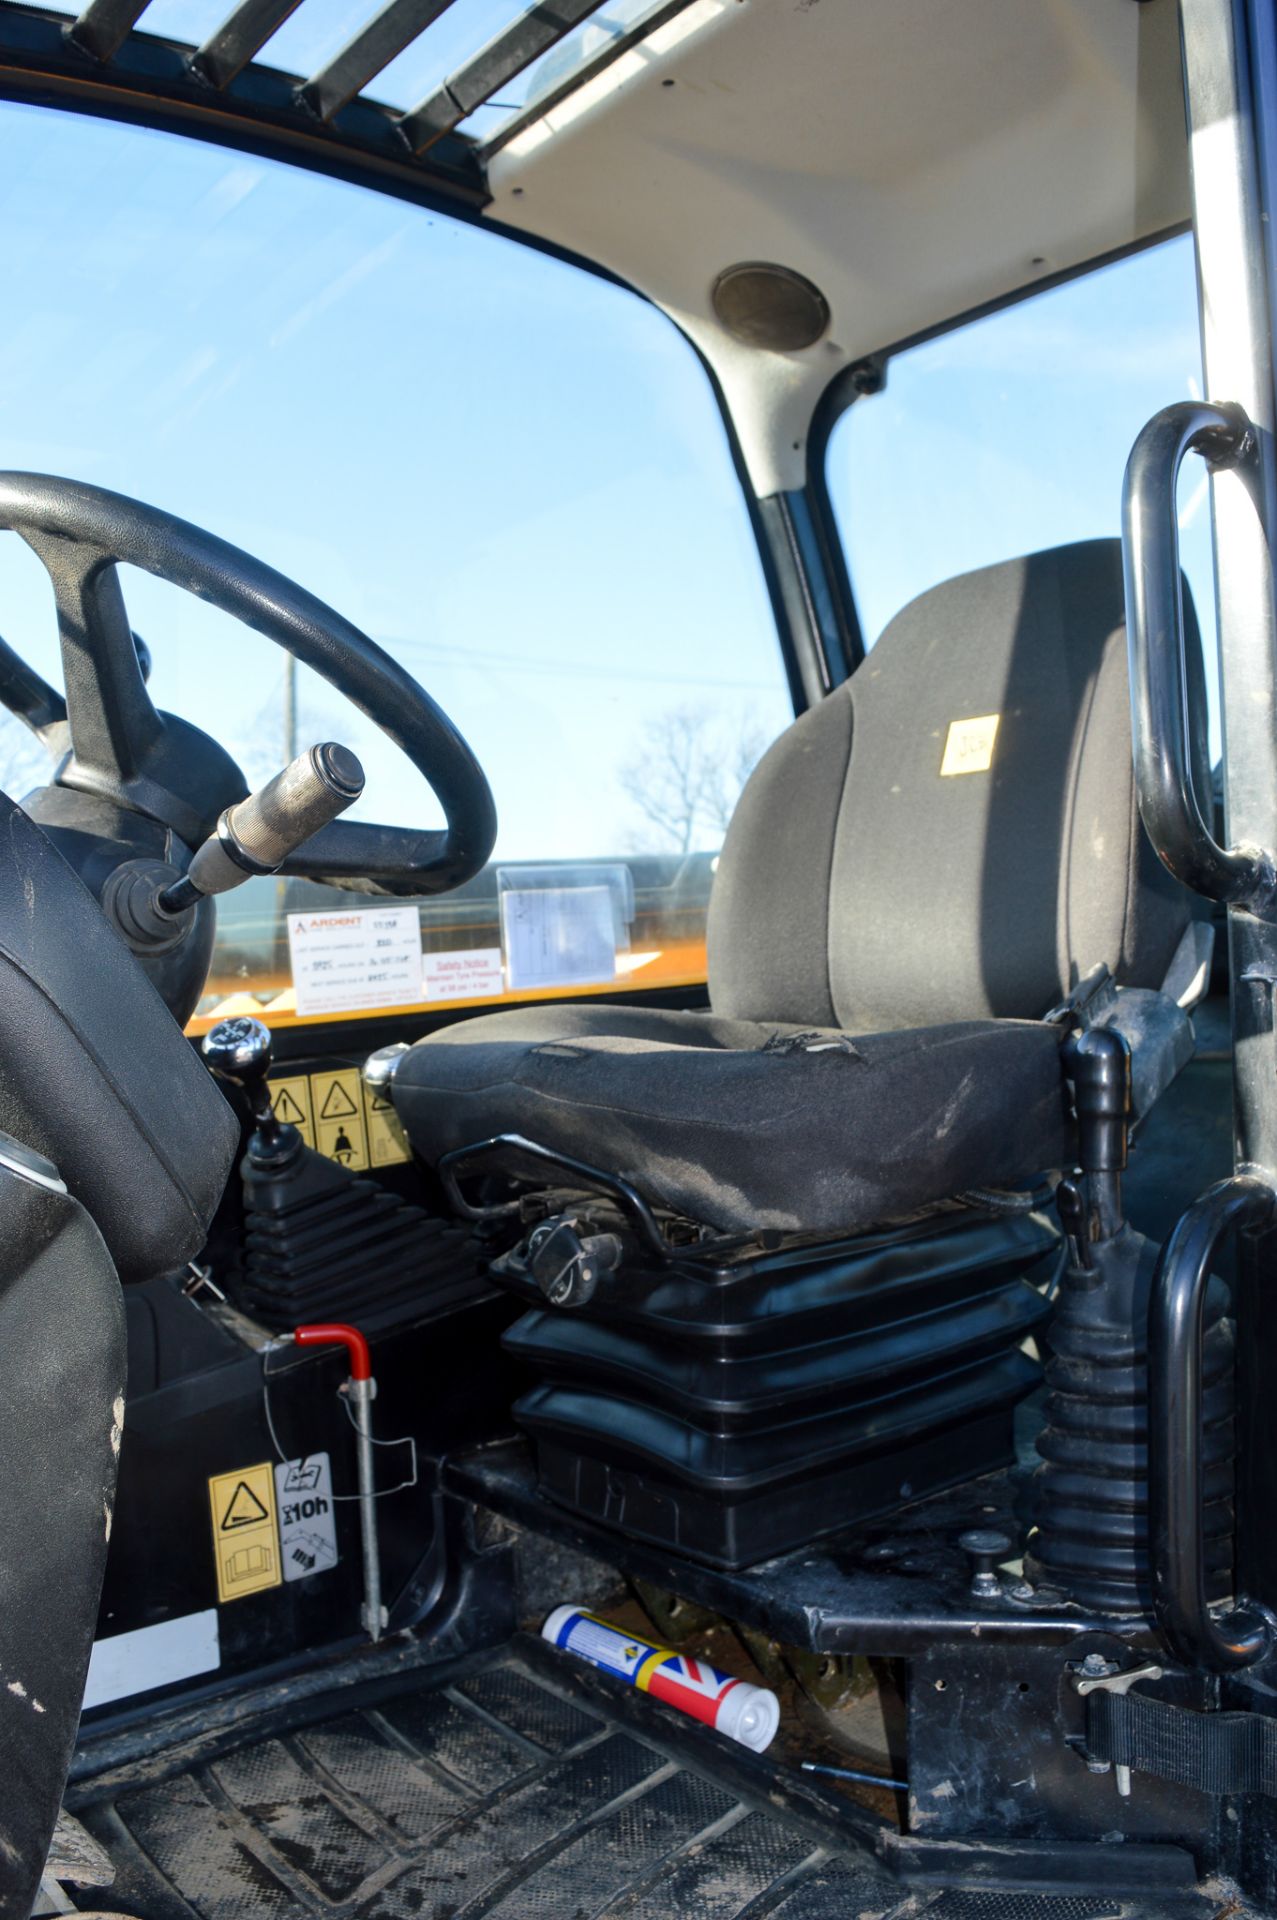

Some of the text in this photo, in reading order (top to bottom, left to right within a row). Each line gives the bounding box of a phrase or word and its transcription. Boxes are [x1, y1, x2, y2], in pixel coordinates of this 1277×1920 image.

[310, 916, 363, 928] ARDENT
[464, 959, 489, 969] Notice
[293, 1497, 328, 1521] 10h
